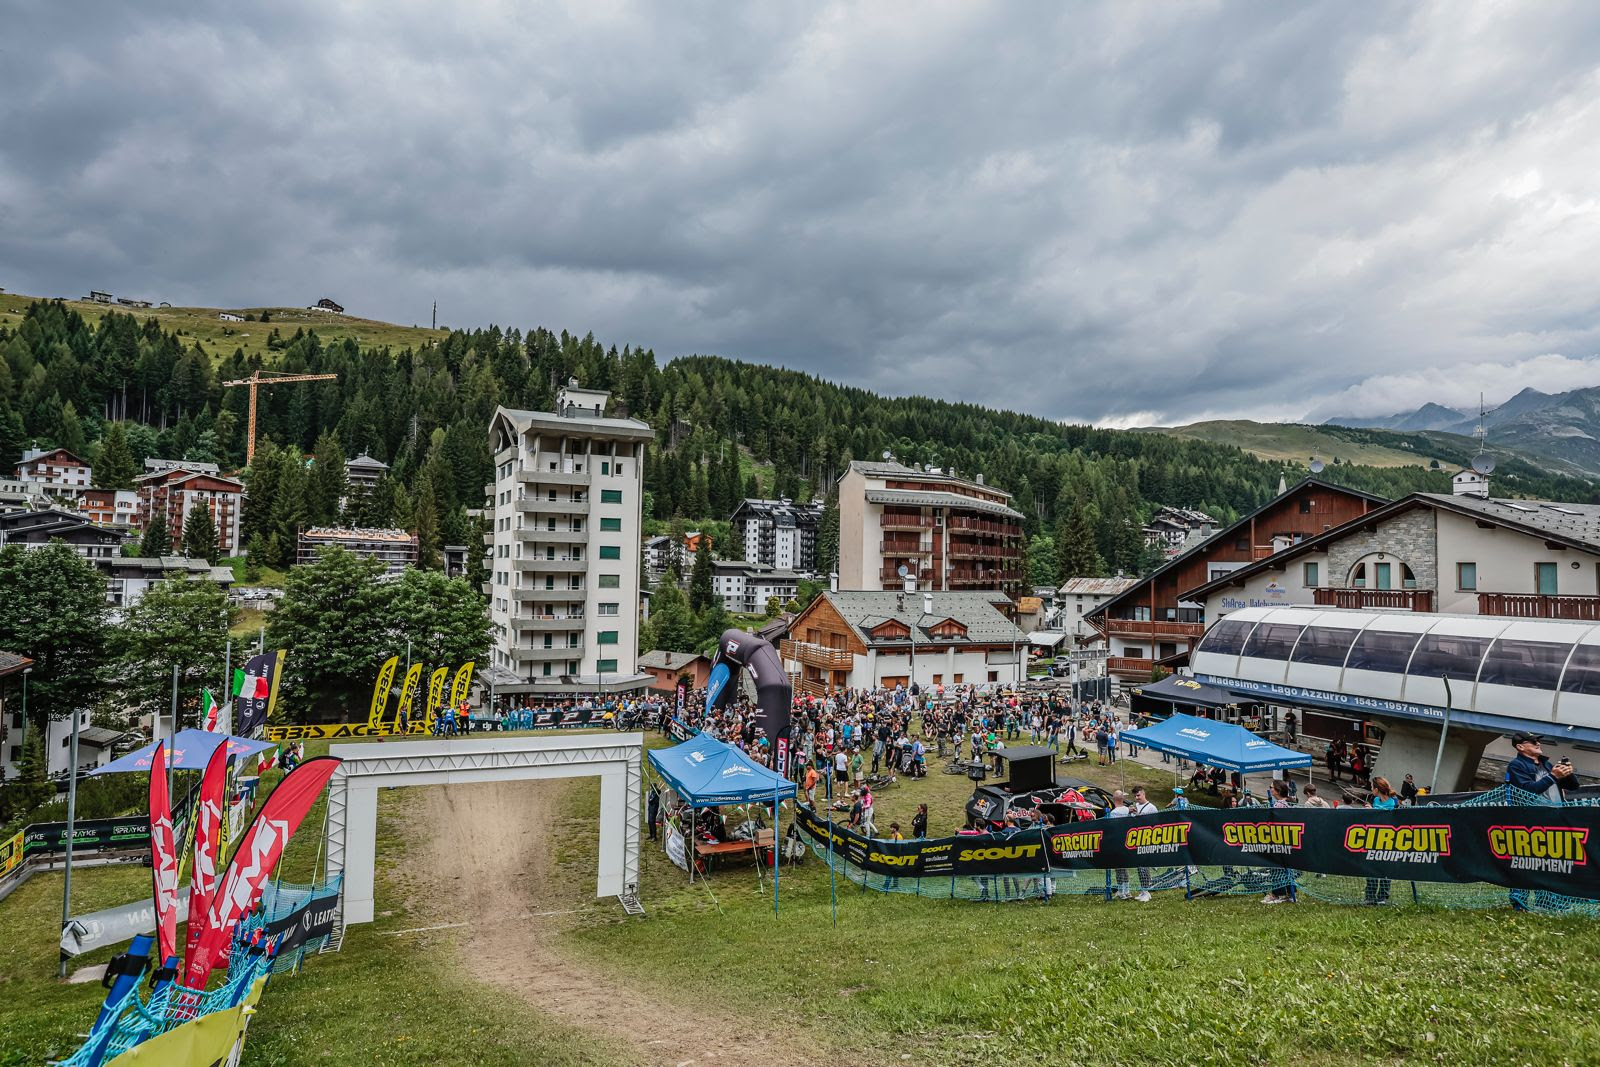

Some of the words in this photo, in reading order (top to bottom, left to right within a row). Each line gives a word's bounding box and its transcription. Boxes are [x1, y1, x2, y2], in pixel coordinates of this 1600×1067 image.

[1208, 675, 1259, 690] Madesimo
[1271, 683, 1298, 697] Lago
[1301, 688, 1348, 703] Azzurro
[1423, 708, 1444, 717] slm
[1052, 832, 1101, 852] CIRCUIT
[1127, 823, 1189, 847] CIRCUIT
[1224, 824, 1302, 846] CIRCUIT
[1347, 827, 1449, 851] CIRCUIT
[920, 844, 953, 854] SCOUT
[958, 843, 1041, 862] SCOUT
[1137, 844, 1180, 855] EQUIPMENT
[1241, 843, 1292, 855] EQUIPMENT
[1490, 829, 1585, 860] CIRCUIT
[869, 851, 919, 867] SCOUT
[1062, 850, 1094, 859] EQUIPMENT
[1366, 850, 1439, 864] EQUIPMENT
[1511, 856, 1574, 874] EQUIPMENT
